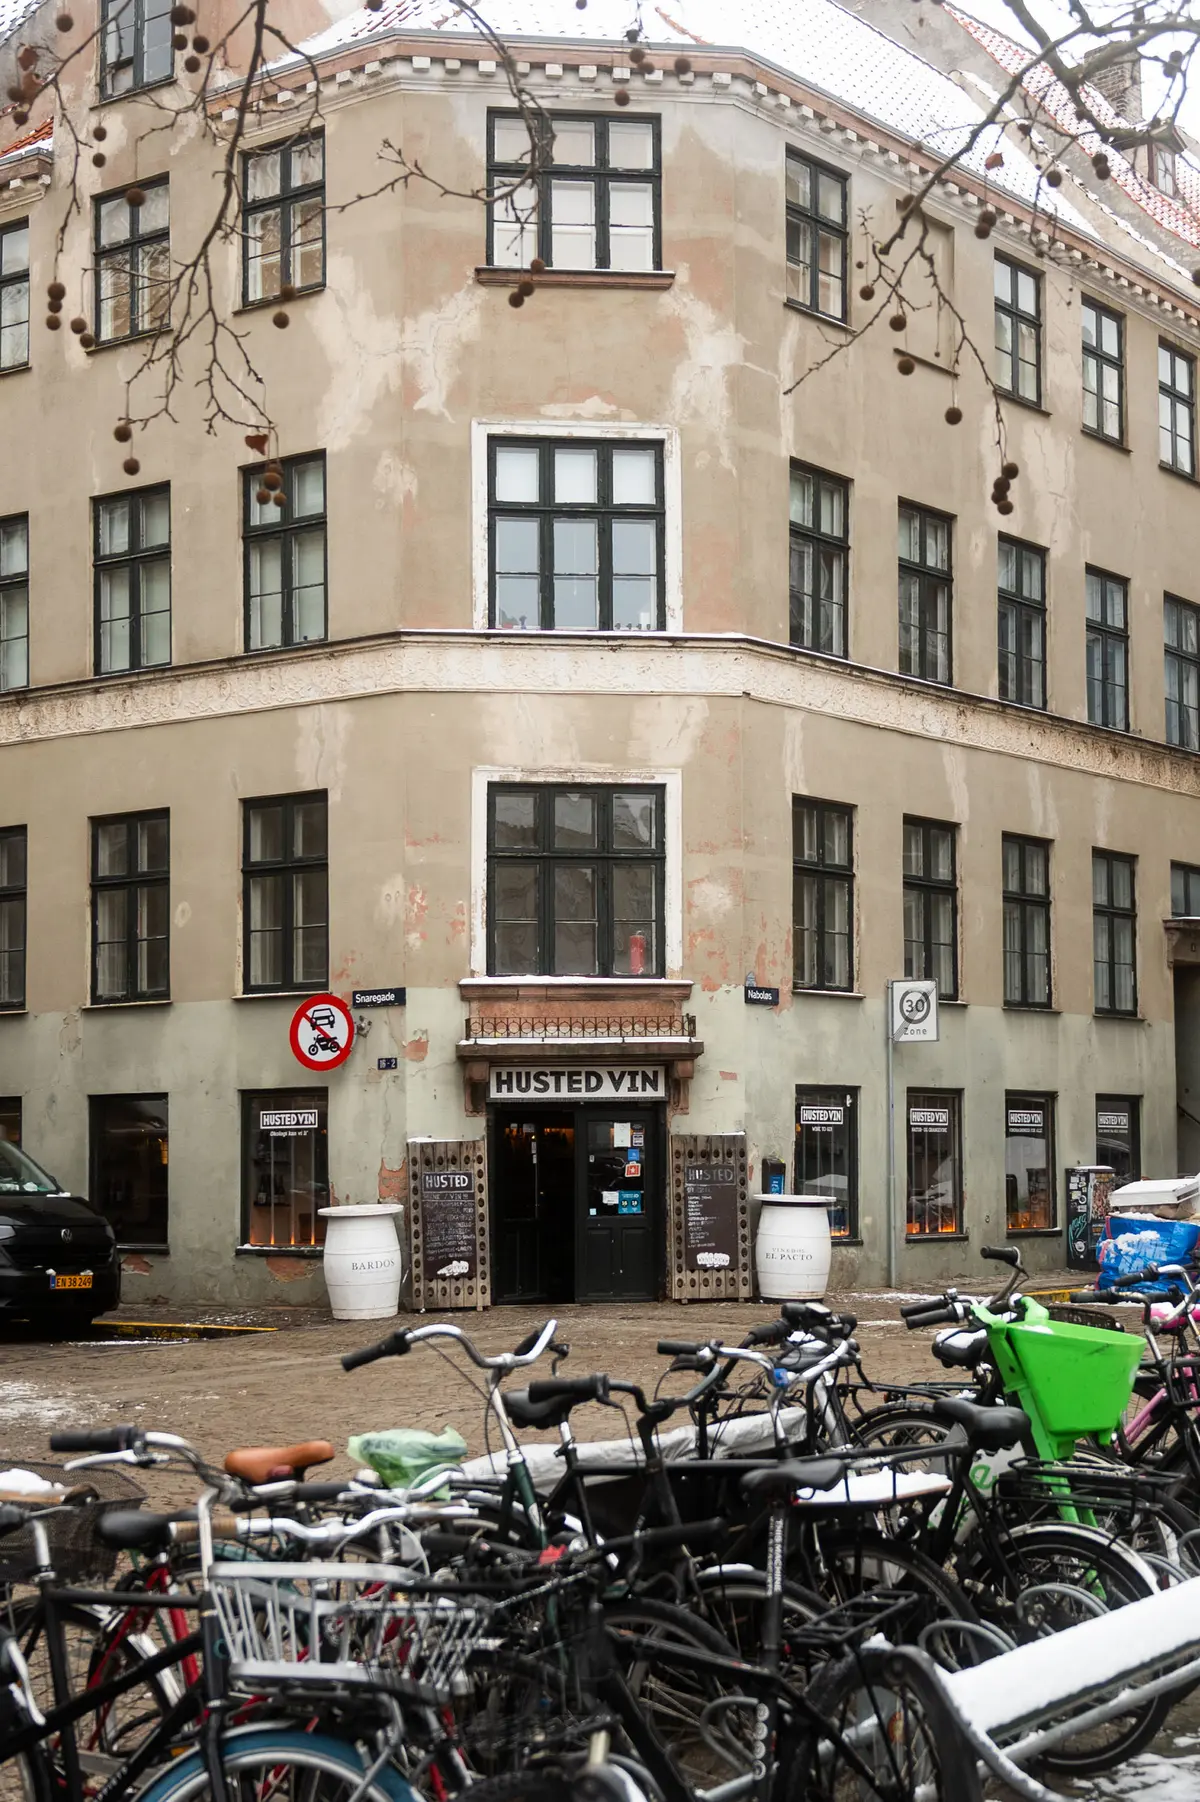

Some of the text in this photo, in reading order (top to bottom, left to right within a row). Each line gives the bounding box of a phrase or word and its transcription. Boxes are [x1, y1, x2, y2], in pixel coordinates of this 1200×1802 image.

[355, 992, 395, 1003] Snaregade
[905, 999, 925, 1012] 30
[903, 1027, 927, 1035] Zone
[495, 1071, 659, 1093] HUSTED VIN
[263, 1113, 315, 1125] HUSTED VIN
[803, 1110, 841, 1121] HUSTED VIN
[912, 1111, 947, 1122] HUSTED VIN
[1010, 1113, 1041, 1123] HUSTED VIN
[1099, 1115, 1118, 1125] HUSTED
[688, 1169, 733, 1181] HUSTED
[425, 1174, 468, 1188] HUSTED
[765, 1252, 813, 1261] EL PACTO
[351, 1259, 395, 1271] BARDOS
[56, 1277, 92, 1287] EN 38 249
[773, 1519, 784, 1592] THIS MACHINE
